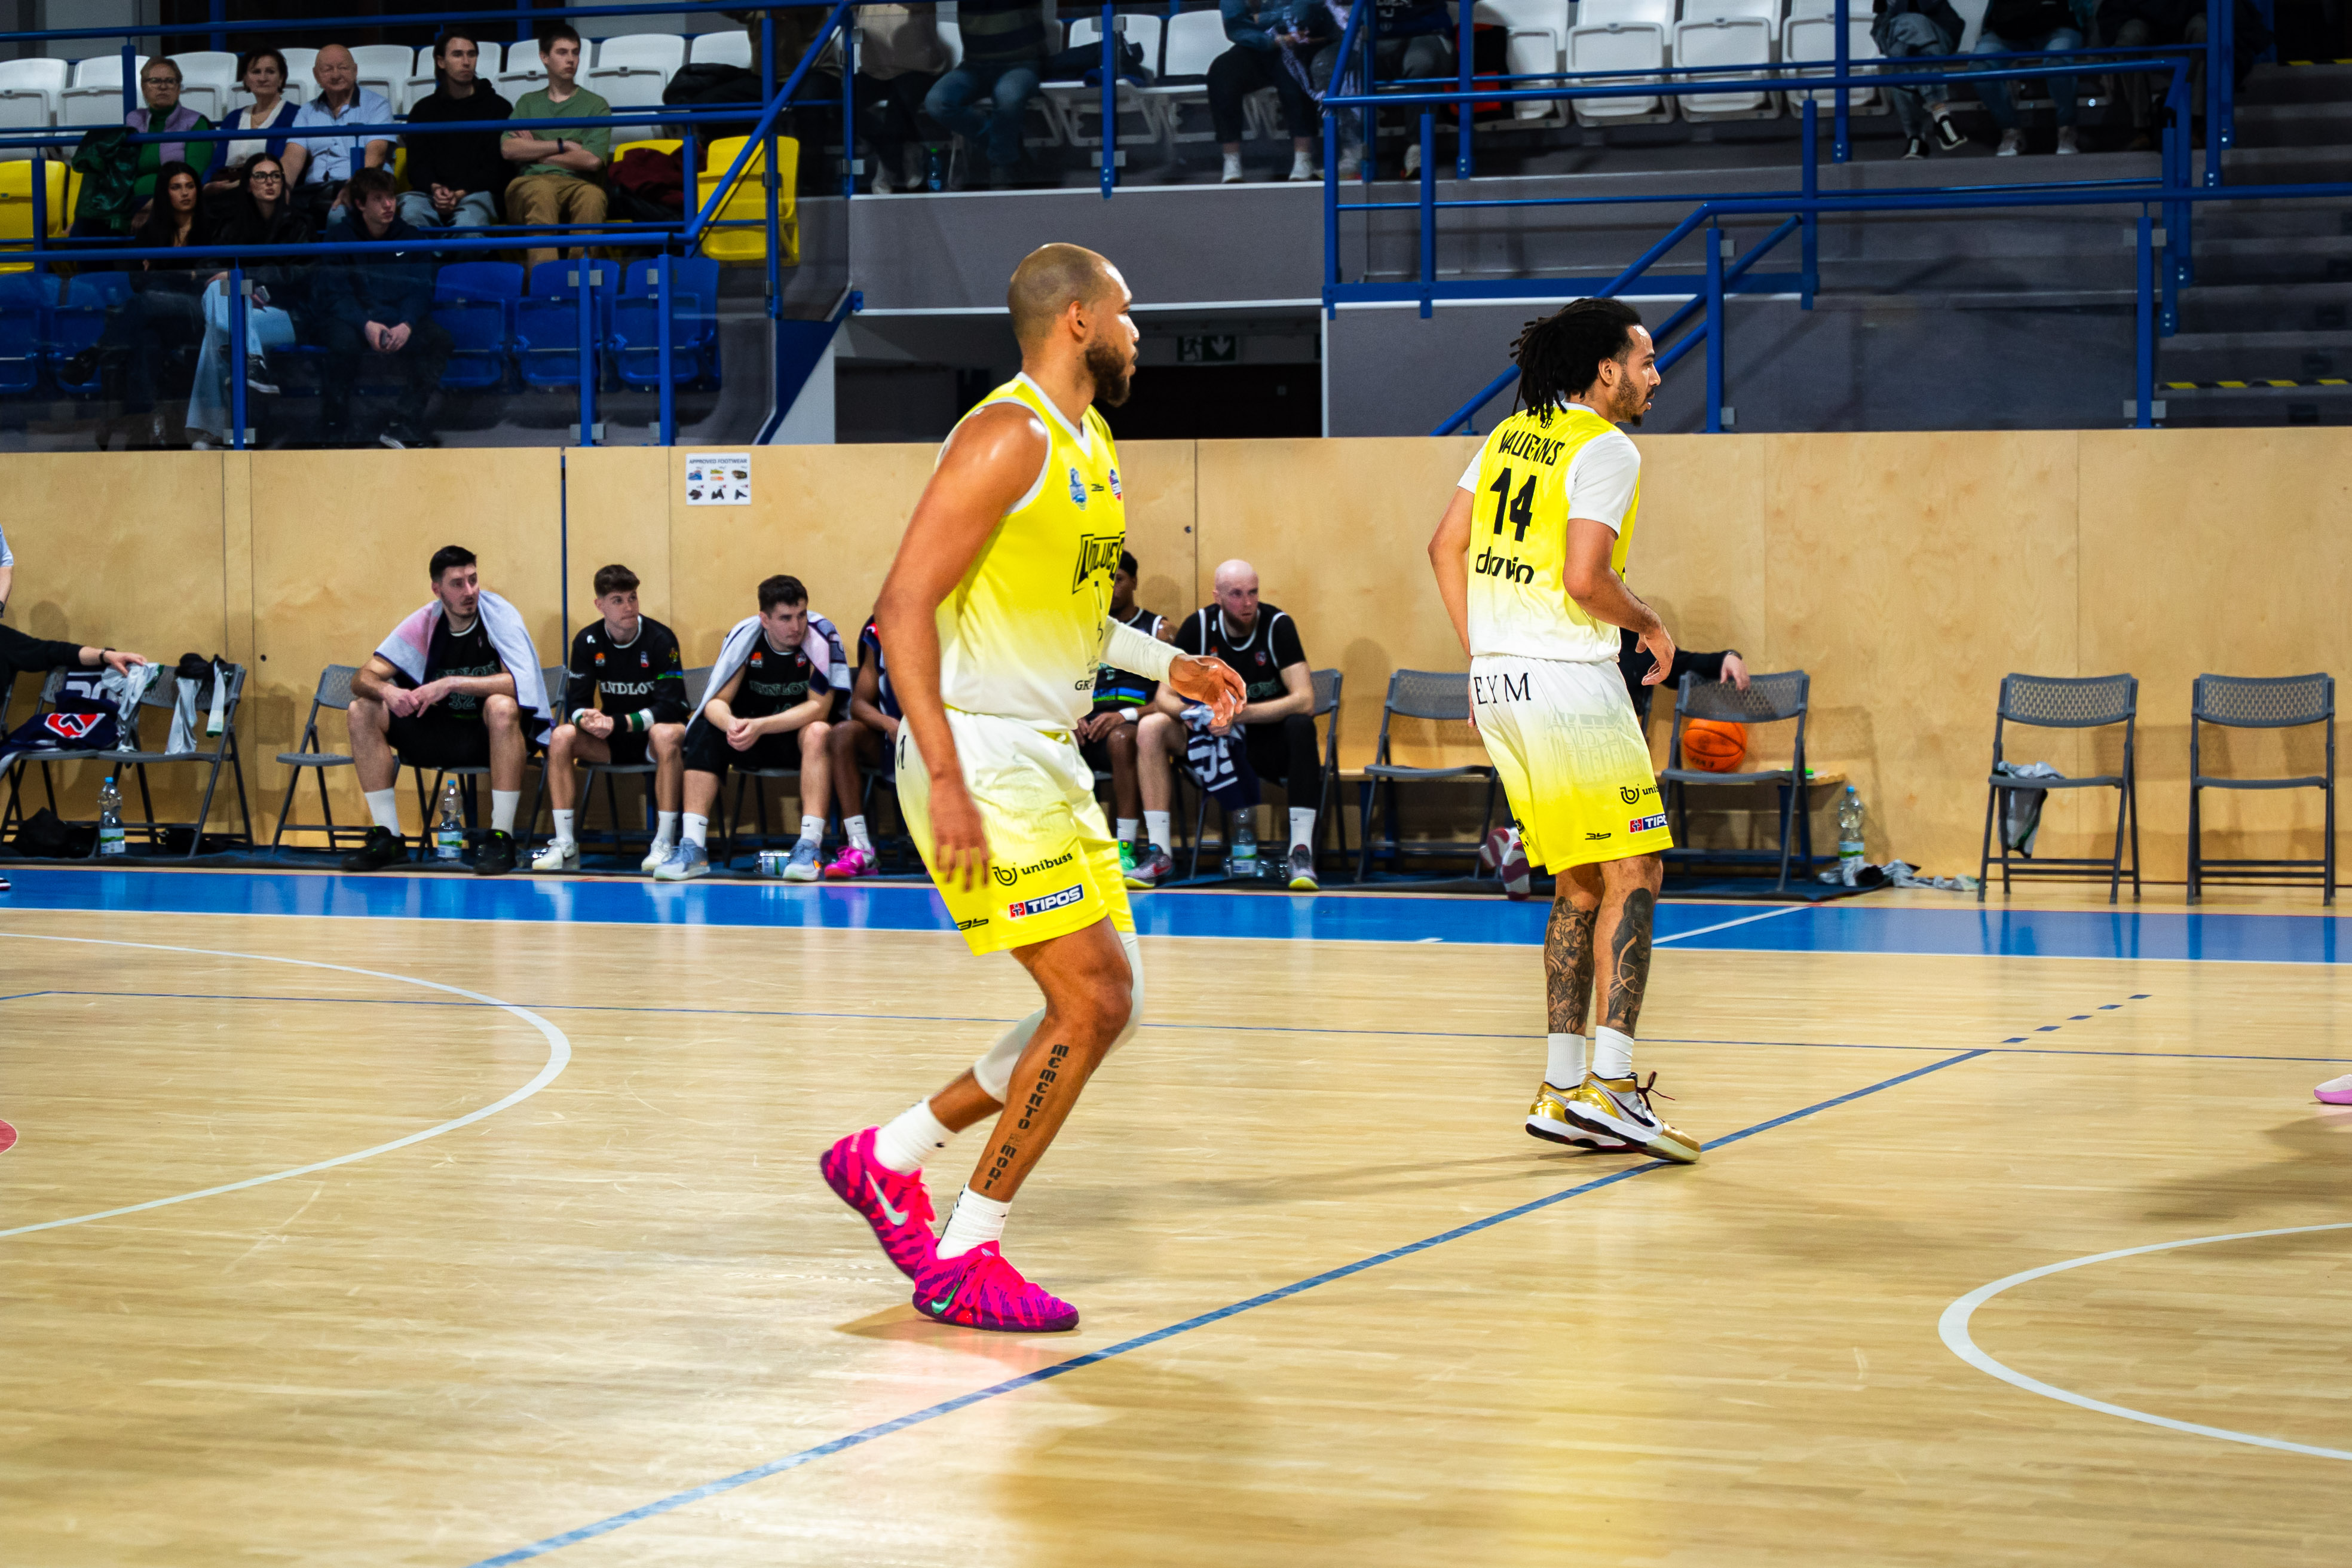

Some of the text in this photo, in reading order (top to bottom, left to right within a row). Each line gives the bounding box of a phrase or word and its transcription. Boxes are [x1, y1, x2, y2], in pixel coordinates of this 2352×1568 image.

[1490, 467, 1537, 542] 14
[1473, 672, 1532, 705] EYM
[1021, 853, 1073, 875] unibuss
[1028, 887, 1080, 912] TIPOS
[1018, 1045, 1070, 1129] MEMENTO
[984, 1144, 1017, 1190] MORI
